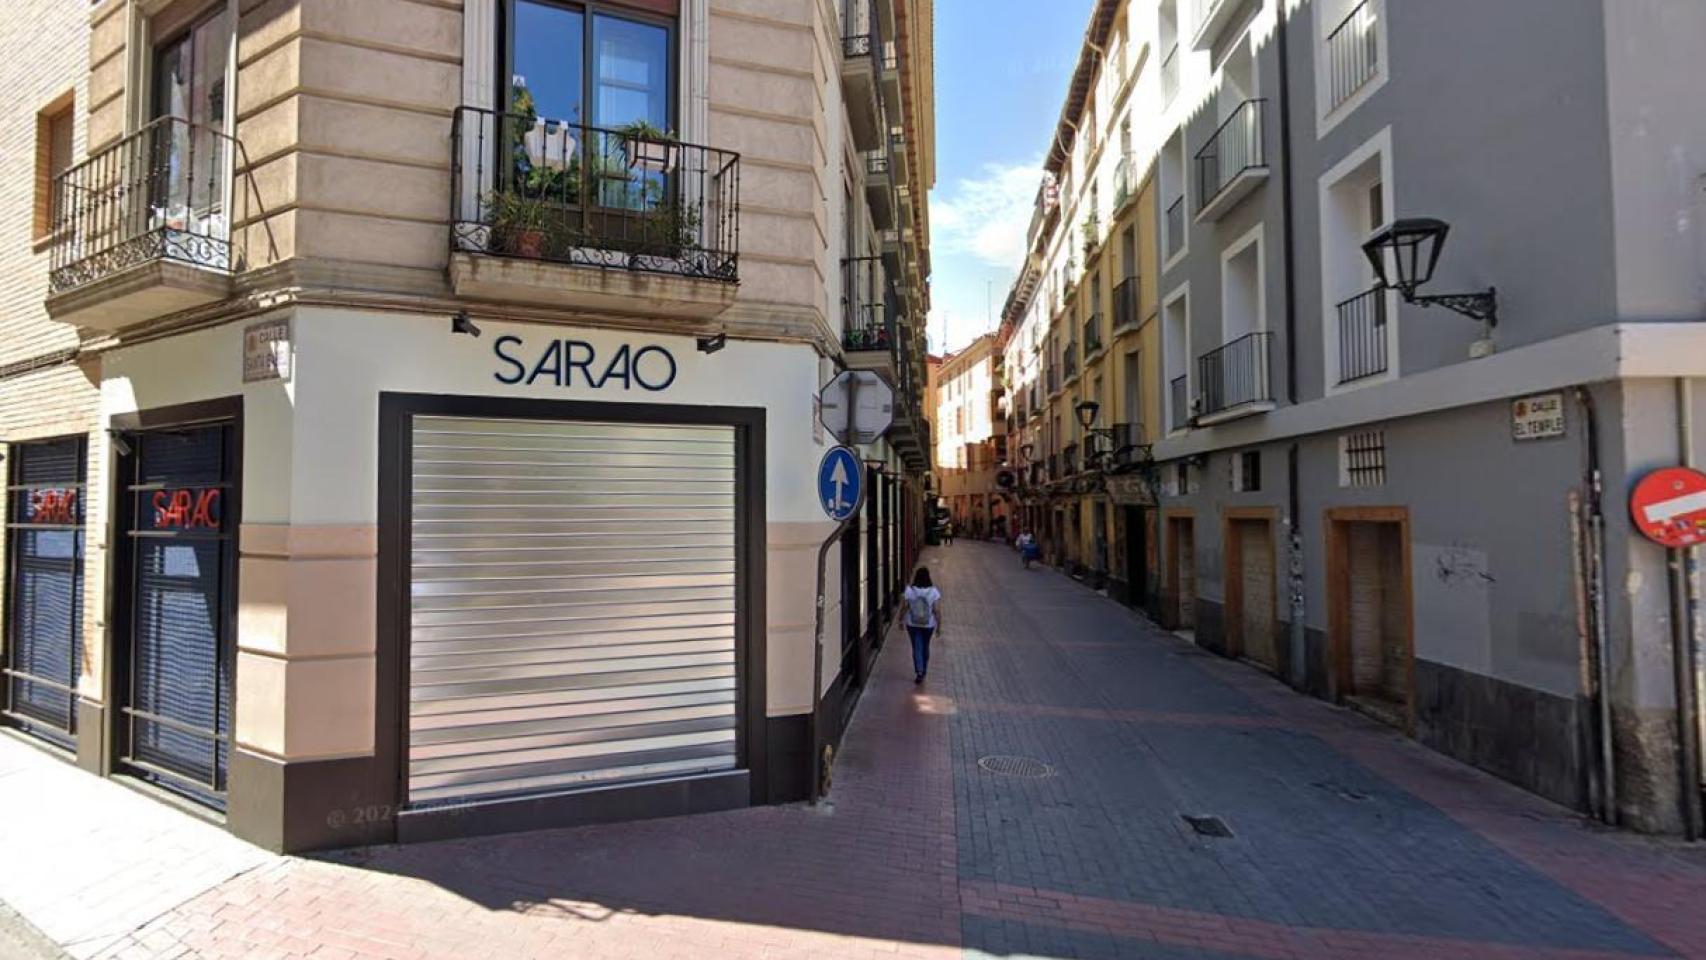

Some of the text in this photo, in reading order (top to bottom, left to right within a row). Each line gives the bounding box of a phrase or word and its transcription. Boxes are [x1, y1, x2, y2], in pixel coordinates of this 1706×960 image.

[259, 327, 286, 344] CALLE
[493, 335, 677, 392] SARAO
[1531, 400, 1557, 412] CALLE
[1528, 417, 1564, 433] TEMPLE
